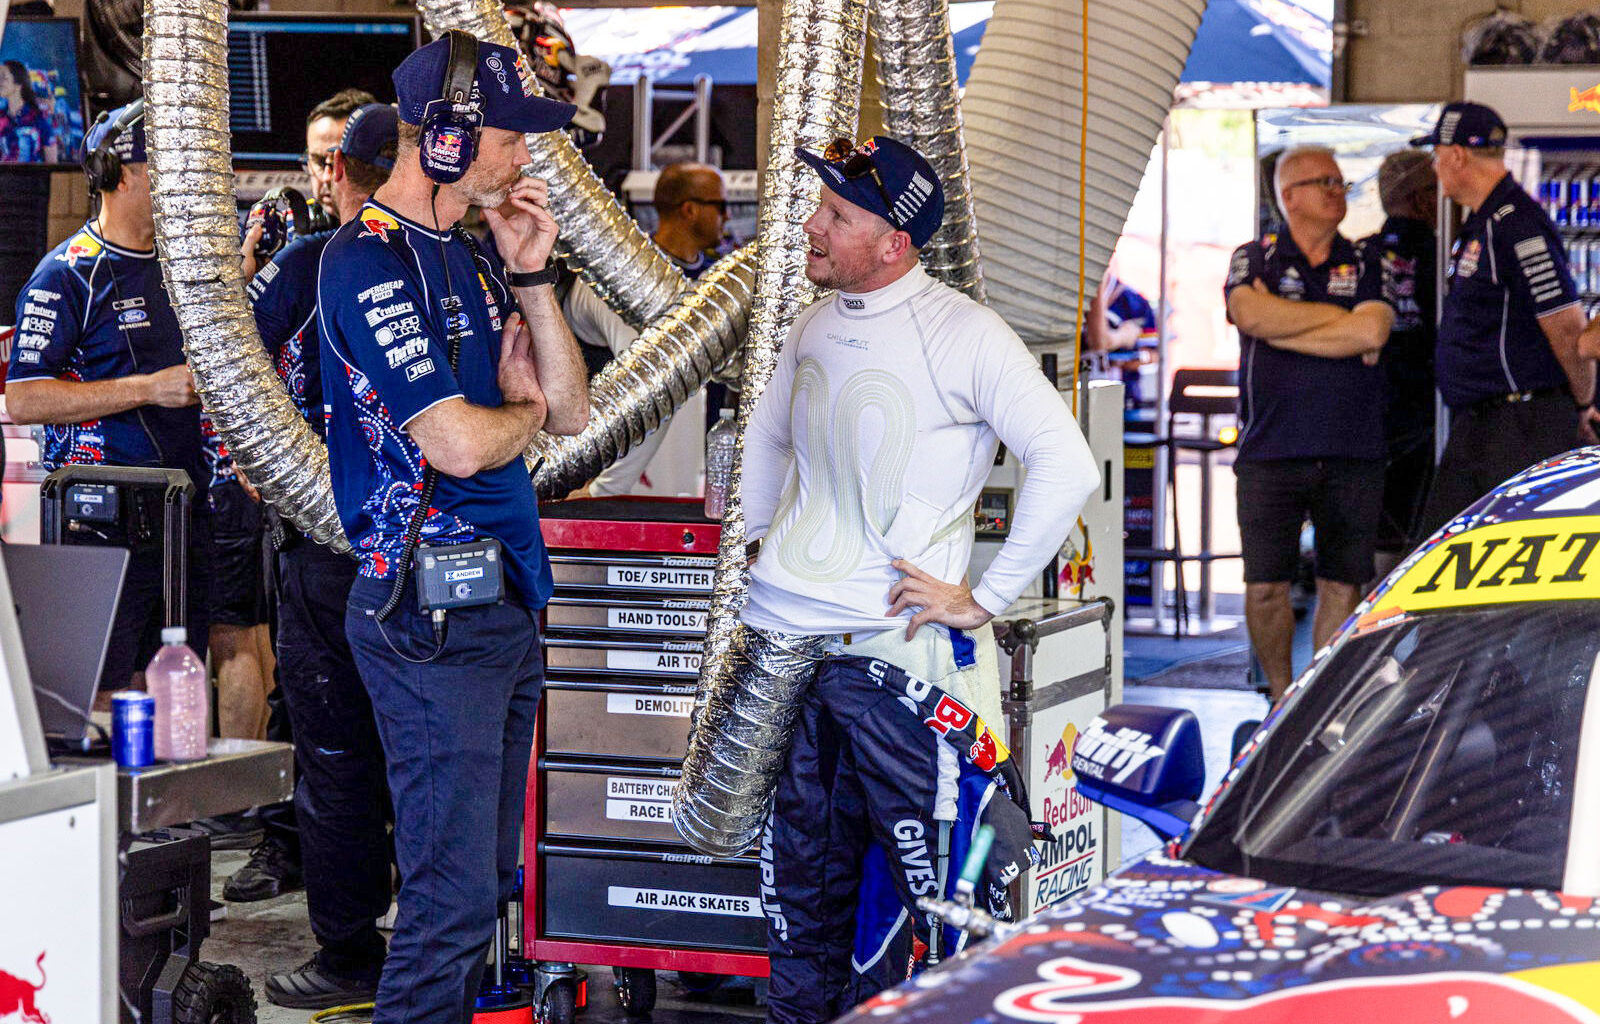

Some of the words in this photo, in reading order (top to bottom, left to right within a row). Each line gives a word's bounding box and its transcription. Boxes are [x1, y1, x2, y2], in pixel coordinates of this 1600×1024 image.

[432, 147, 461, 158] AMPOL
[357, 279, 404, 304] SUPERCHEAP
[374, 291, 392, 300] AUTO
[368, 301, 414, 325] Century
[388, 315, 420, 331] QUAD
[393, 324, 422, 339] LOCK
[385, 336, 429, 366] Thrifty
[409, 361, 432, 379] JGI
[456, 570, 481, 578] ANDREW
[617, 570, 648, 583] TOE/
[651, 571, 709, 585] SPLITTER
[618, 611, 653, 624] HAND
[656, 613, 706, 628] TOOLS/
[662, 641, 704, 651] ToolPR
[657, 655, 680, 668] AIR
[683, 656, 700, 669] TO
[662, 684, 698, 693] ToolP
[635, 699, 692, 713] DEMOLIT
[1073, 755, 1104, 779] RENTAL
[611, 782, 655, 796] BATTERY
[630, 804, 664, 819] RACE
[1043, 788, 1068, 827] Red
[1036, 822, 1097, 872] AMPOL
[661, 853, 713, 864] ToolPRO
[893, 819, 939, 896] GIVES
[760, 808, 790, 944] MPLIF
[1034, 857, 1093, 908] RACING
[635, 892, 658, 905] AIR
[661, 894, 695, 908] JACK
[699, 897, 750, 913] SKATES
